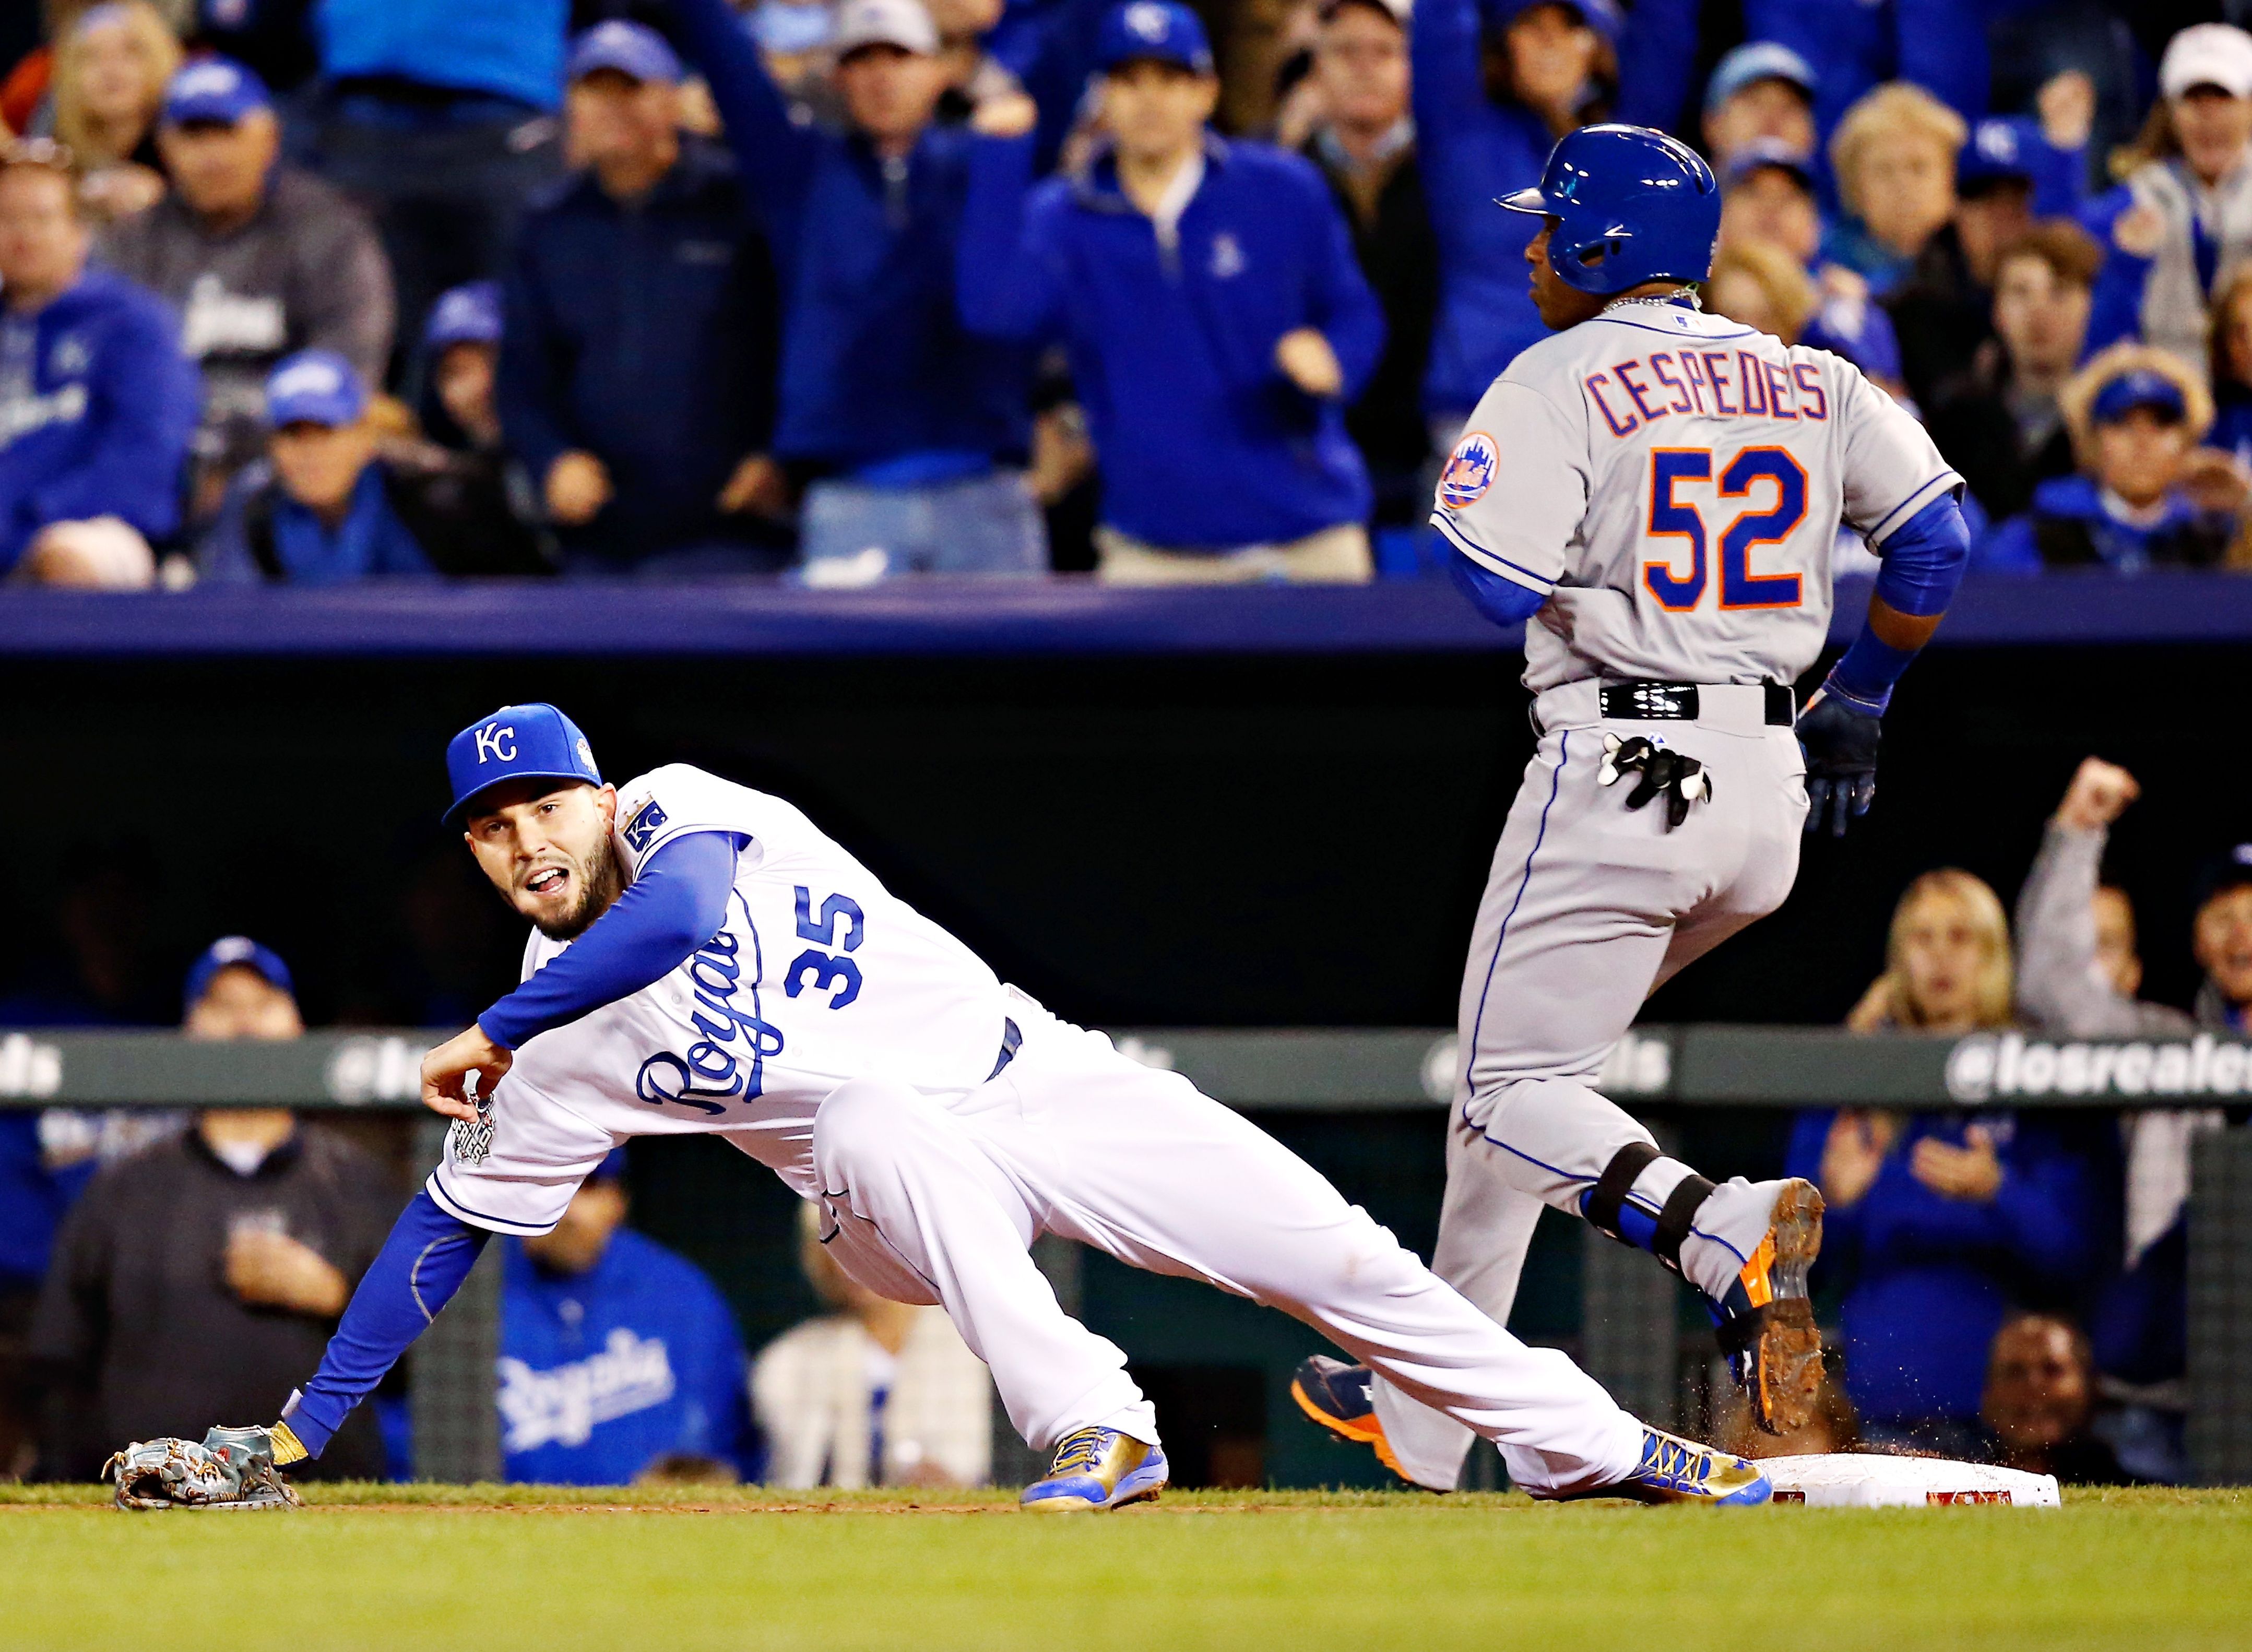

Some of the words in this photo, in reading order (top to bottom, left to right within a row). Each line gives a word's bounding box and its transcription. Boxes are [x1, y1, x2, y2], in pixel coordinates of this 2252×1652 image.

[1586, 349, 1827, 438] CESPEDES
[1643, 445, 1809, 612] 52
[474, 721, 517, 764] KC
[627, 807, 666, 847] KC
[784, 885, 864, 1009] 35
[1945, 1031, 2252, 1102] @losreale
